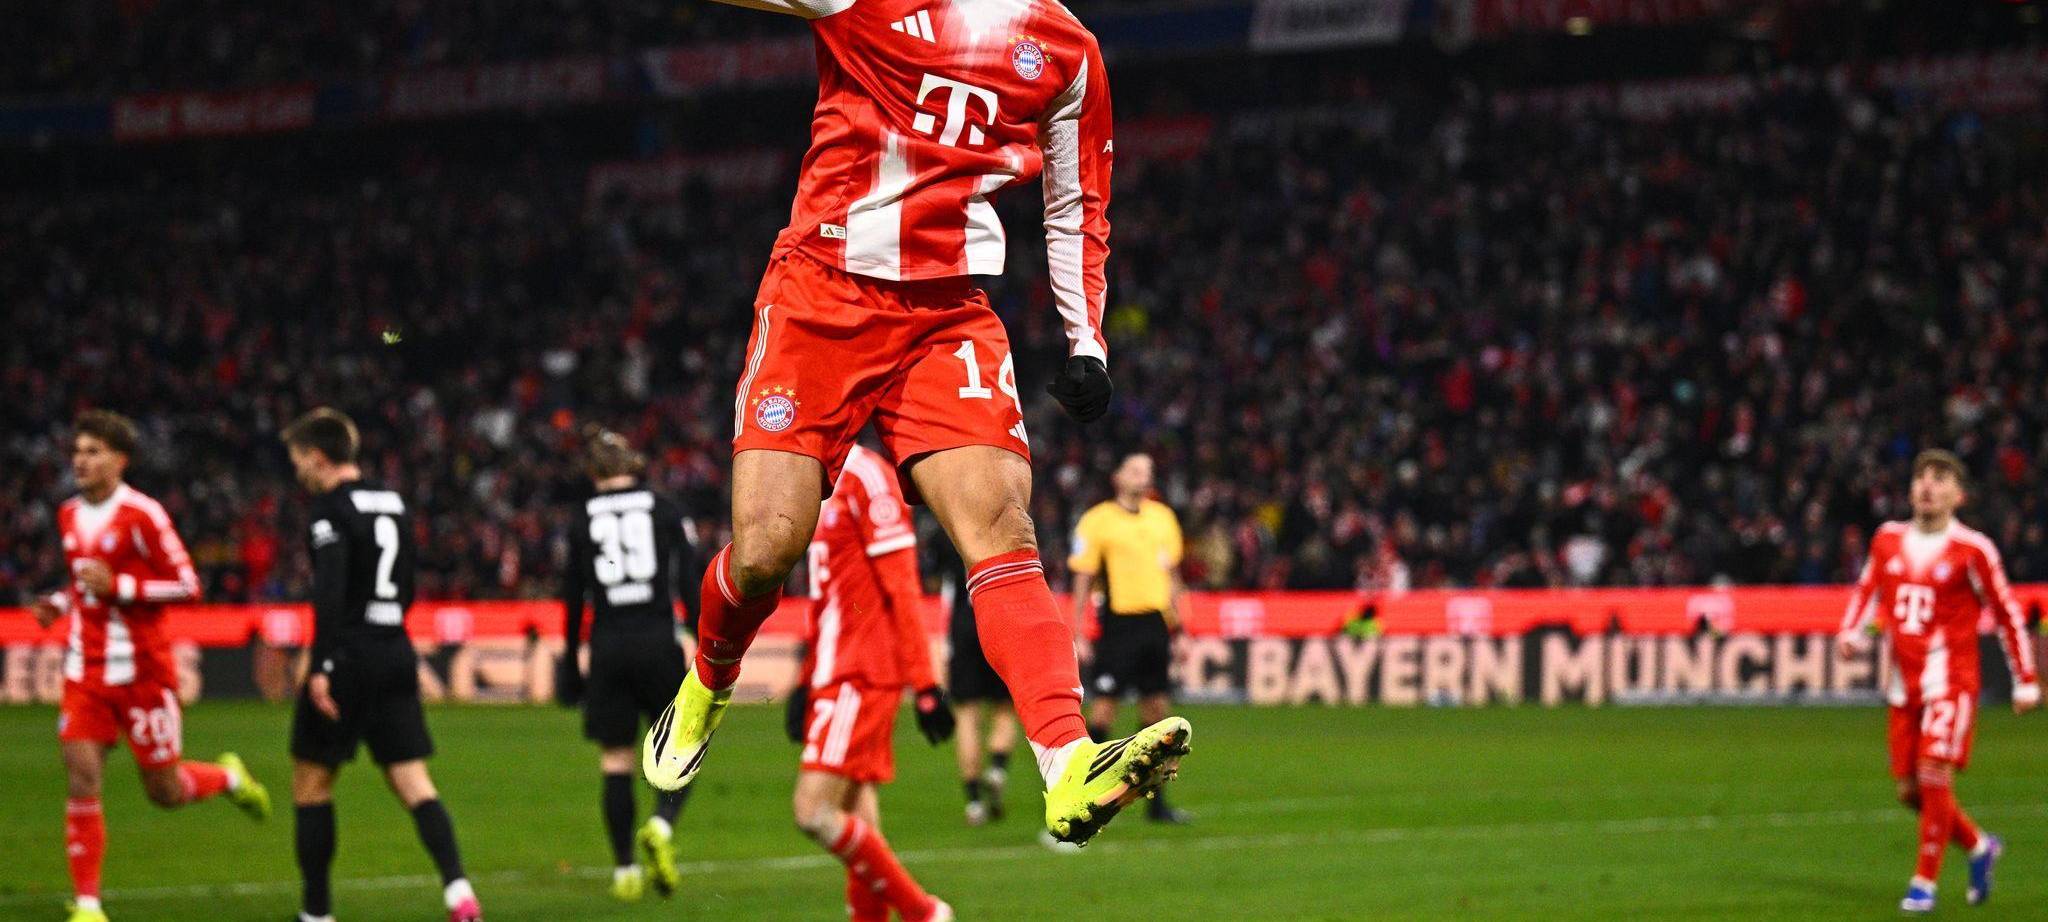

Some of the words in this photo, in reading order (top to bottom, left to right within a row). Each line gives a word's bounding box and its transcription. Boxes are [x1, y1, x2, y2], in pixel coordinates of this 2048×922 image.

[912, 73, 998, 148] T
[768, 398, 792, 412] BAYERN
[374, 515, 399, 598] 2
[589, 511, 657, 587] 39
[1894, 582, 1936, 635] T
[1249, 633, 1523, 705] BAYERN
[128, 706, 172, 745] 20
[808, 699, 835, 742] 7
[1921, 700, 1956, 738] 12
